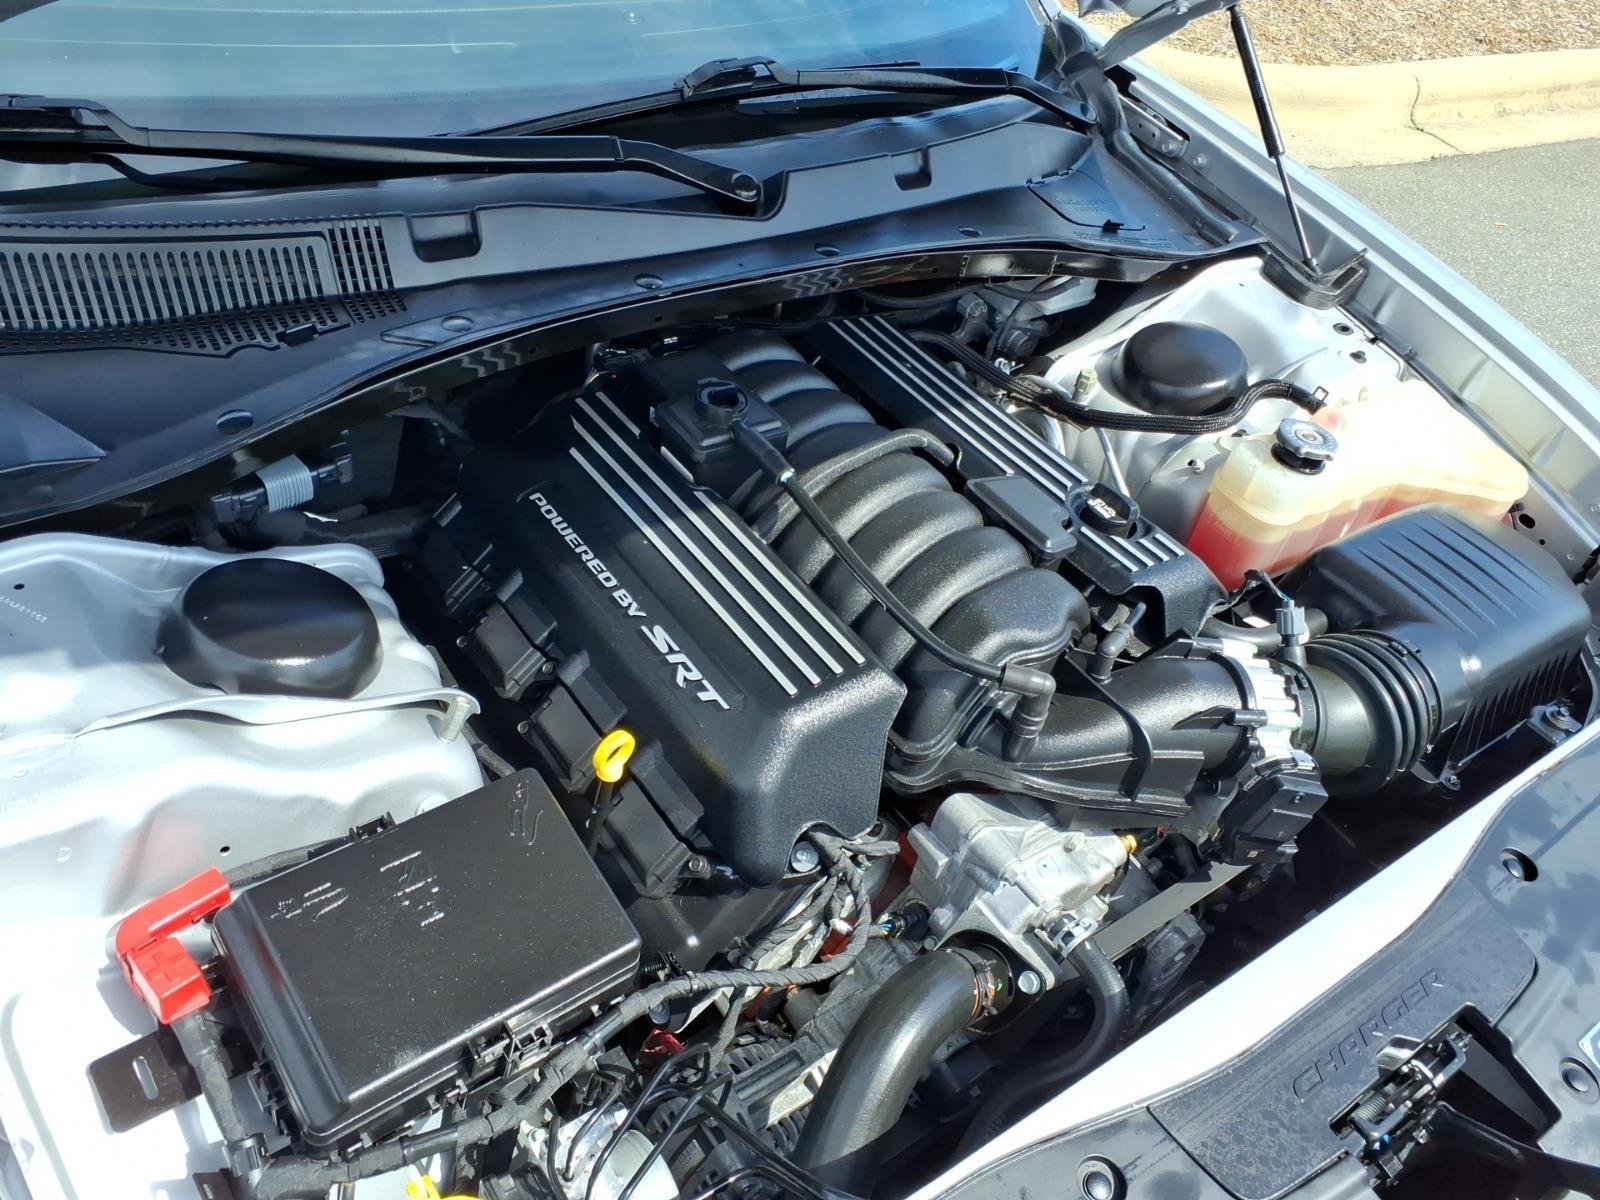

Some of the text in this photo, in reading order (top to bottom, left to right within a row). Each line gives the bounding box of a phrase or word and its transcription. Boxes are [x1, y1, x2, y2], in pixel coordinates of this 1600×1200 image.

[528, 492, 731, 710] POWERED BY SRT
[1292, 967, 1445, 1104] CHARGER
